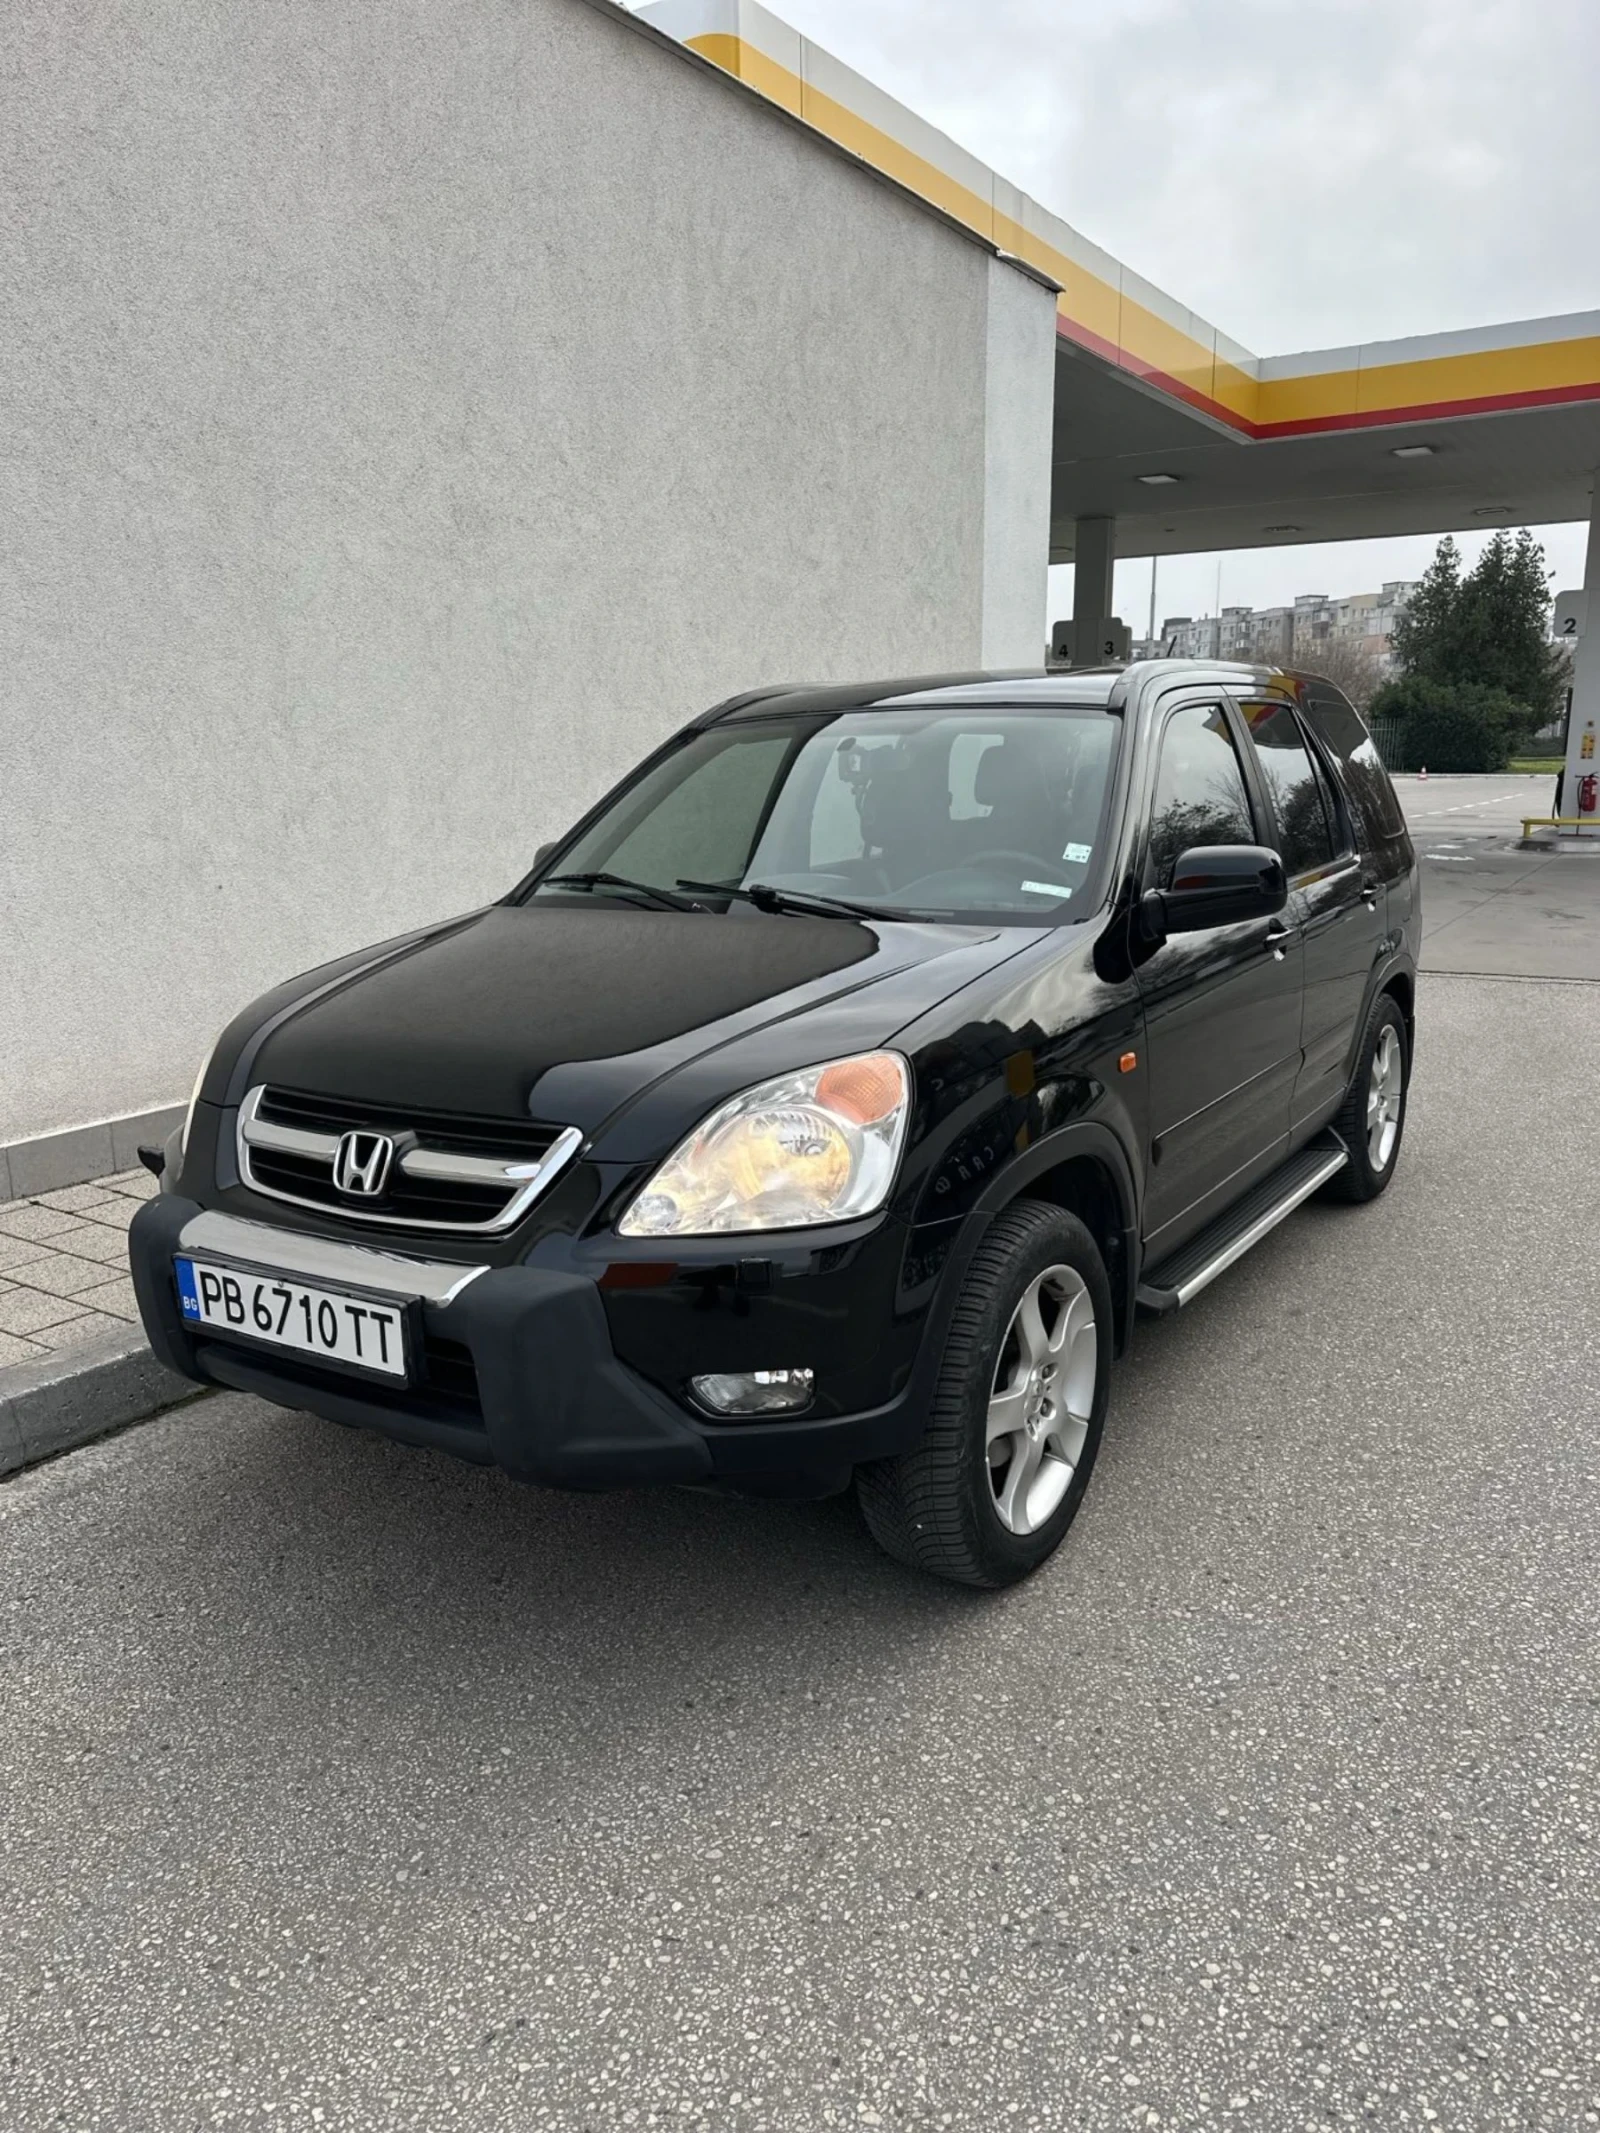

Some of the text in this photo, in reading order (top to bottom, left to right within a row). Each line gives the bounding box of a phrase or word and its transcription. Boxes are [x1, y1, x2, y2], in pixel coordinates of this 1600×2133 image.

[1563, 617, 1577, 634] 2
[1058, 644, 1069, 658] 4
[1104, 641, 1115, 656] 3
[183, 1295, 198, 1311] BG
[199, 1271, 394, 1363] PB 6710 TT
